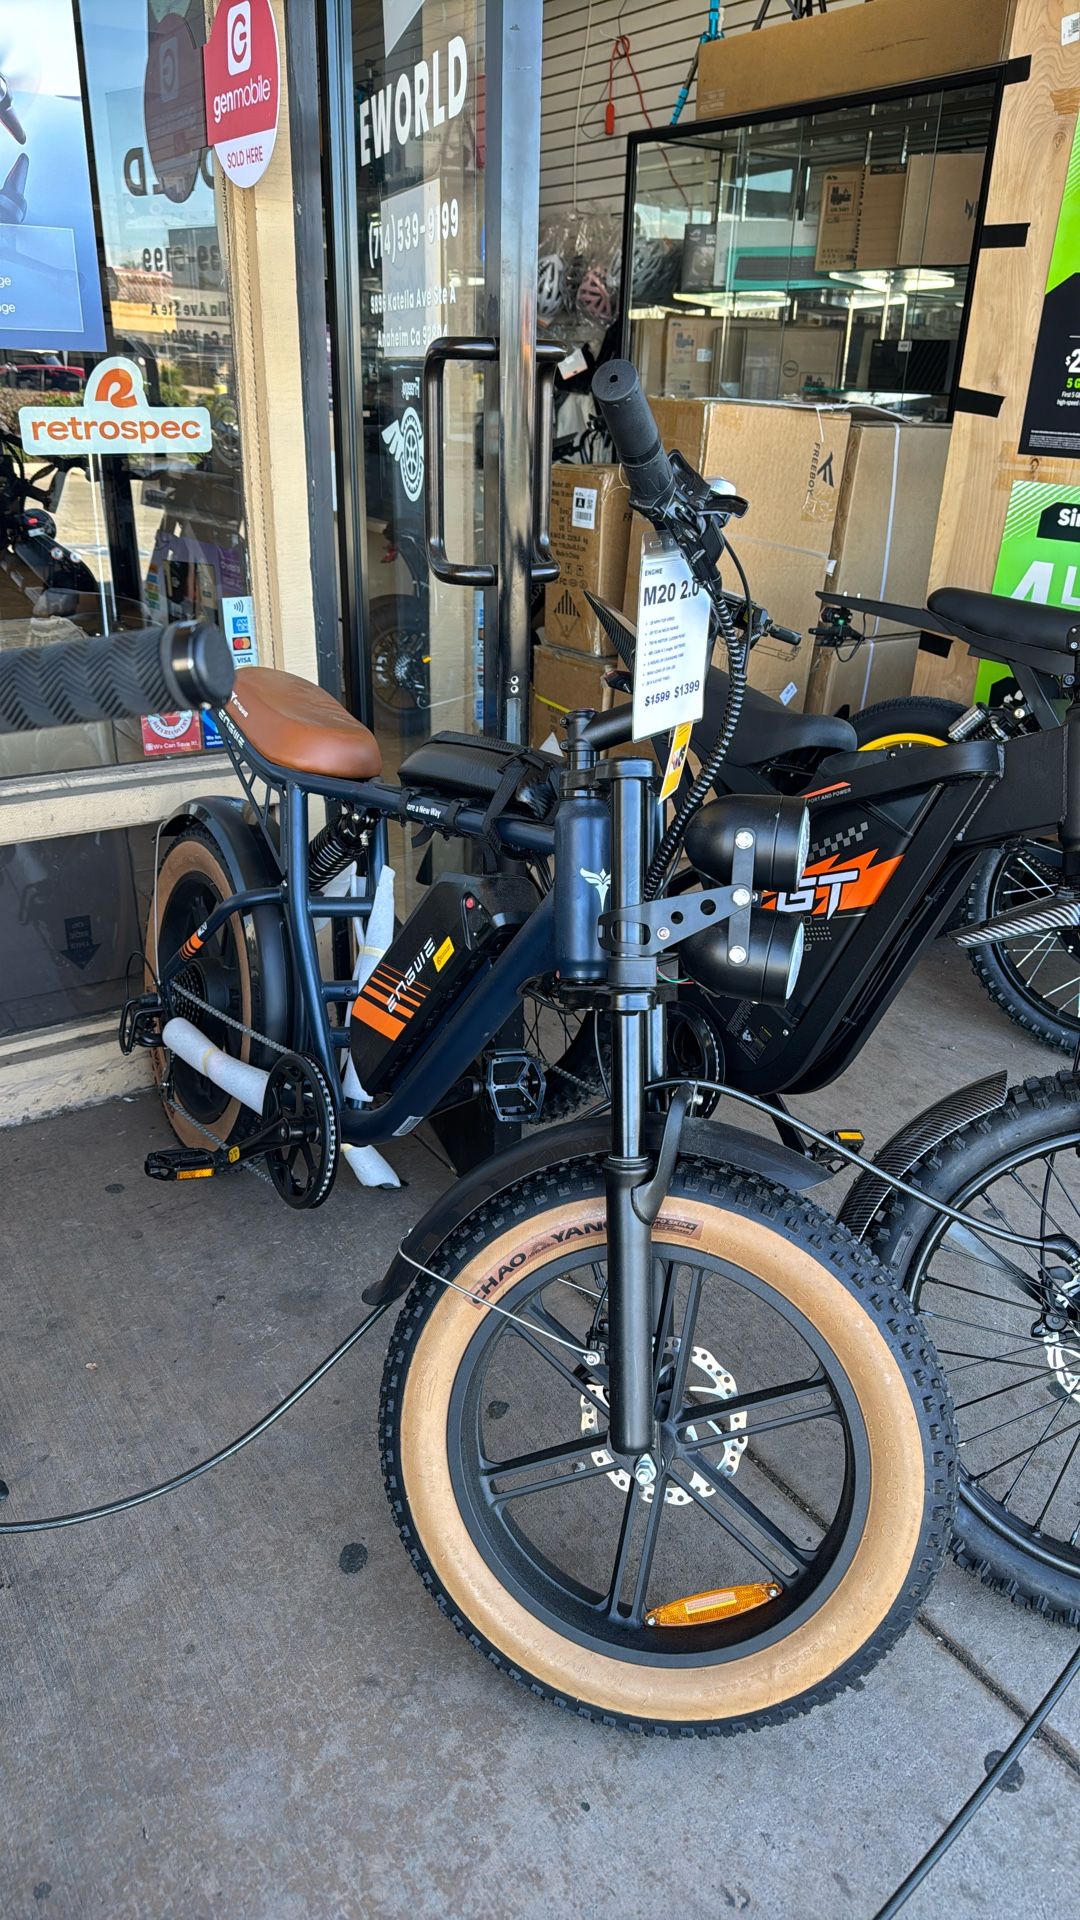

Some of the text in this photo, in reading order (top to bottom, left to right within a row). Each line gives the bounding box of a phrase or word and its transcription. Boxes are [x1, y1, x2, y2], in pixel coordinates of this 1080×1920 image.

[359, 35, 468, 167] EWORLD
[227, 145, 264, 169] SOLD HERE
[387, 289, 414, 312] Katella
[415, 287, 432, 309] Ave
[449, 284, 457, 304] A
[377, 327, 409, 348] Anaheim
[410, 327, 421, 347] Ca
[31, 416, 201, 444] retrospec
[643, 579, 700, 607] M20 2.0
[236, 656, 252, 664] VISA
[644, 690, 671, 707] $1599
[673, 679, 700, 698] $1399
[821, 793, 833, 801] AND
[832, 787, 852, 798] POWER
[419, 804, 431, 815] New
[430, 807, 442, 820] Way
[776, 869, 859, 921] GT
[470, 1220, 608, 1306] CHAO YAN
